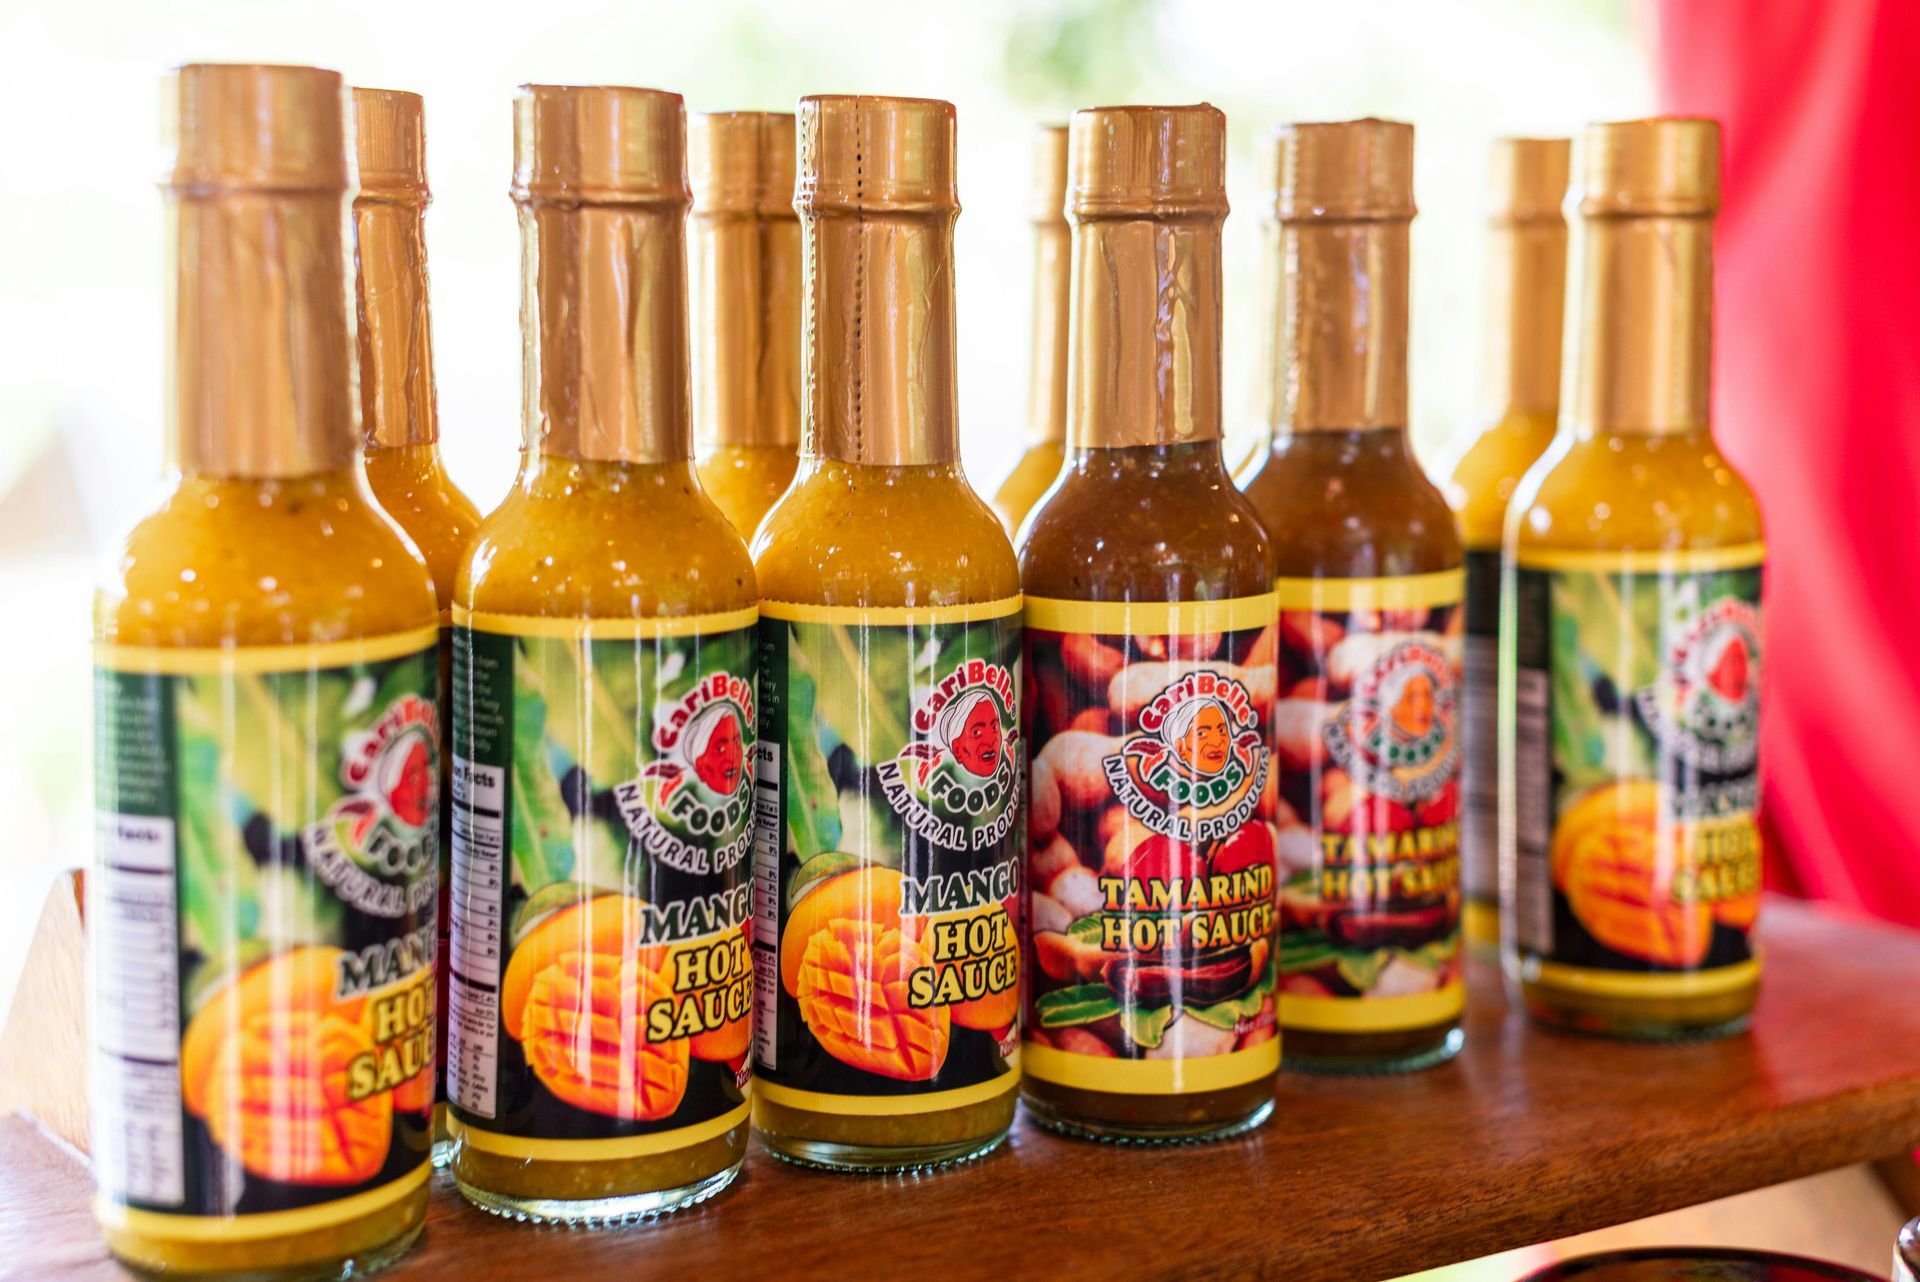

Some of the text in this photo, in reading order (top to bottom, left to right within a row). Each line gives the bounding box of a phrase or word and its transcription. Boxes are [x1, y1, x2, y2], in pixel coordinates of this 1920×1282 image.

[464, 767, 496, 788] Facts
[876, 759, 967, 850] NATURAL
[929, 761, 1011, 816] FOODS
[1103, 747, 1269, 841] NATURAL PRODUCTS
[1151, 762, 1243, 805] FOODS
[614, 781, 710, 875] NATURAL
[671, 780, 751, 836] FOODS
[637, 878, 755, 946] MANGO
[898, 856, 1019, 916] MANGO
[1098, 862, 1274, 912] TAMARIND
[934, 909, 1008, 964] HOT
[1101, 901, 1273, 952] HOT SAUCE
[674, 933, 745, 994] HOT
[908, 950, 1017, 1010] SAUCE
[646, 970, 753, 1044] SAUCE
